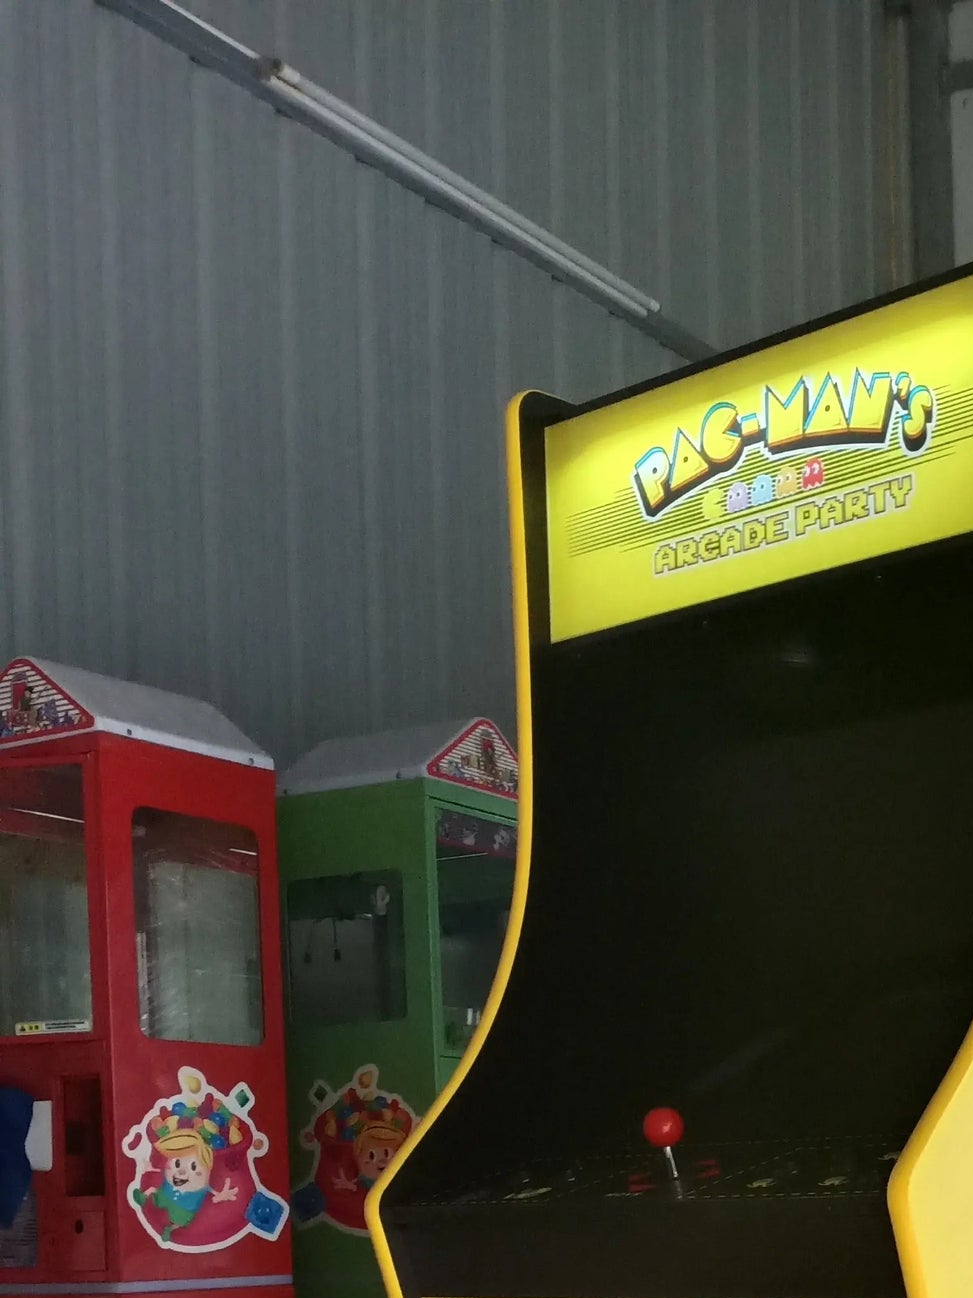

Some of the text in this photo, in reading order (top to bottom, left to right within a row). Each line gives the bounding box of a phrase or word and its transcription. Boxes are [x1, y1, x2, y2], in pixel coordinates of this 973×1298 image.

[633, 366, 935, 517] PAC-MAN'S
[654, 475, 913, 575] ARCADE PARTY
